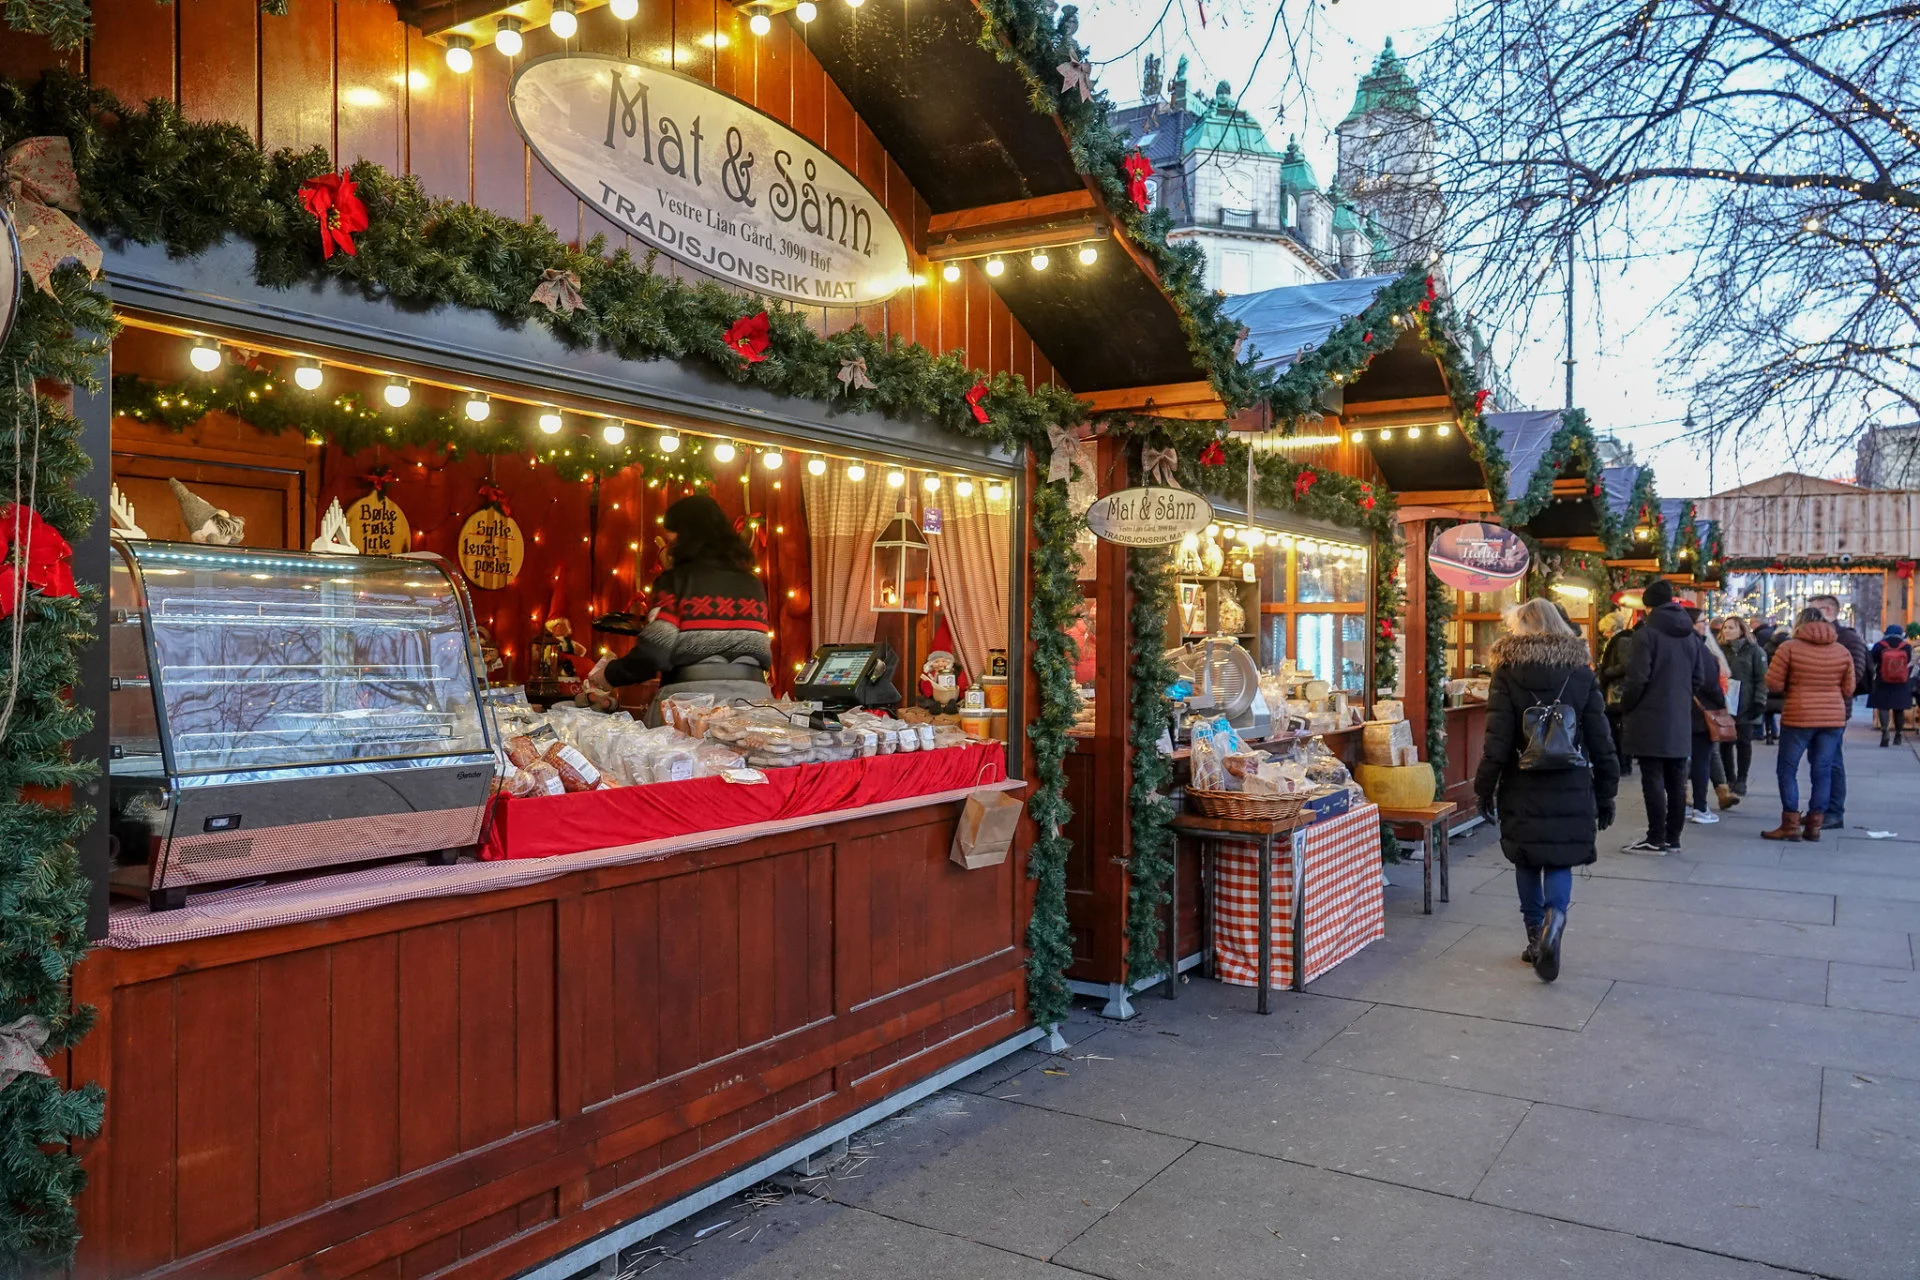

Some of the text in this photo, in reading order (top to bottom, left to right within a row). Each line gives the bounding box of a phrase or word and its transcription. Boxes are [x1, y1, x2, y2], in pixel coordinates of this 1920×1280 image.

[604, 68, 873, 258] Mat & Sånn
[597, 180, 857, 300] TRADISJONSRIK MAT
[656, 188, 833, 273] Vestre Lian Gård, 3090 Hof
[360, 501, 398, 521] Bøke
[1106, 494, 1196, 521] Mat & Sånn
[362, 521, 396, 535] røkt
[1103, 530, 1167, 544] TRADISJONSRIK
[362, 535, 391, 554] jule
[1462, 547, 1499, 559] Italia
